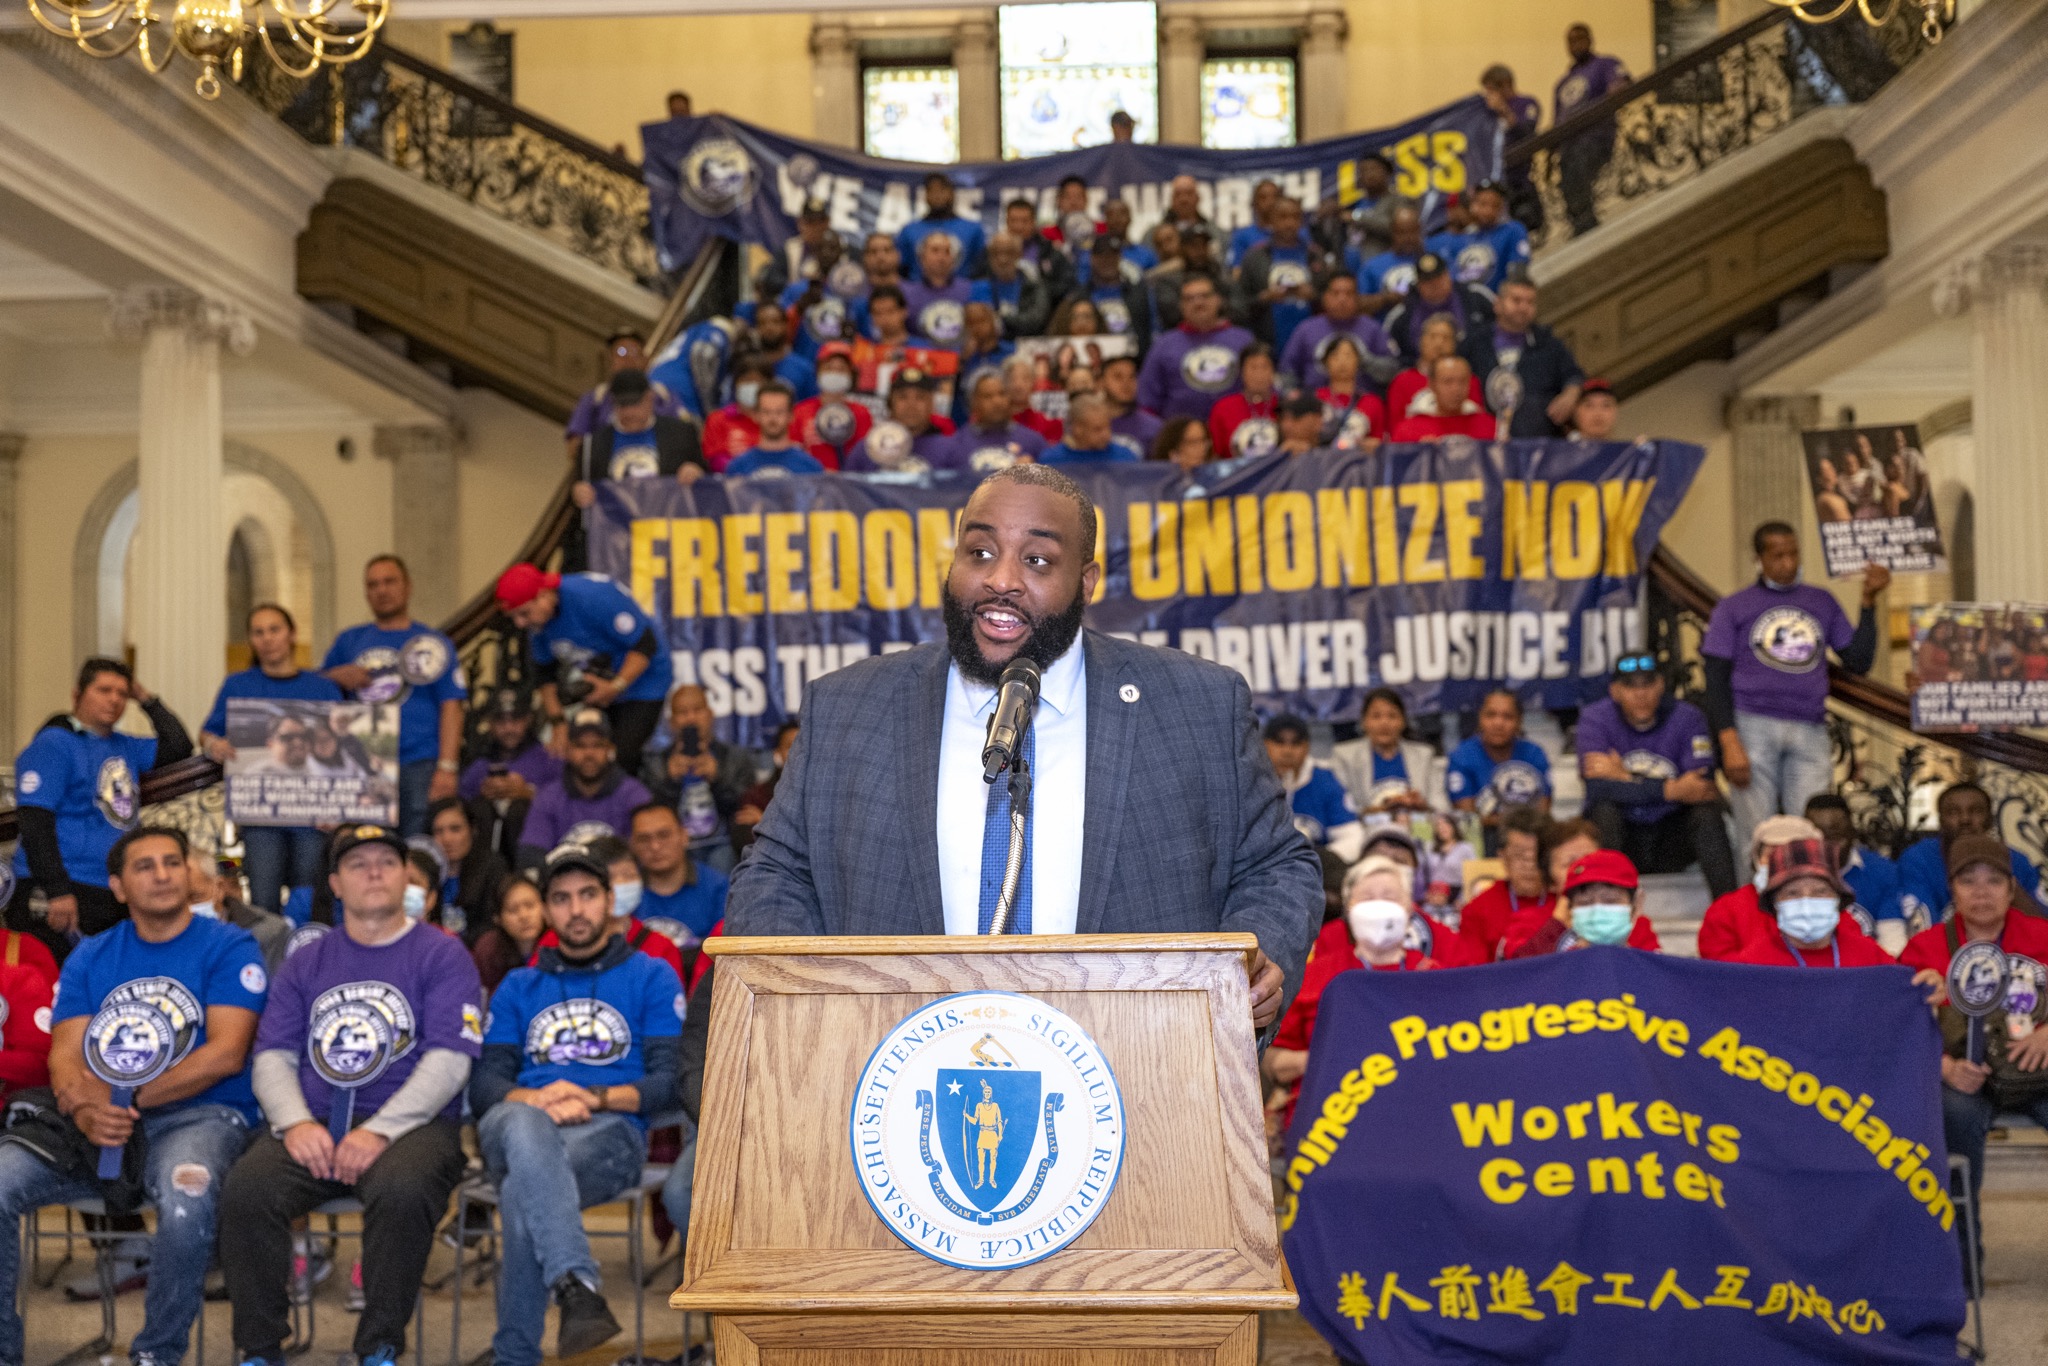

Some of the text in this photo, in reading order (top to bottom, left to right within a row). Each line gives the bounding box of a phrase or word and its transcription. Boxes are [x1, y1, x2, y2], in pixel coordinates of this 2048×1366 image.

[1336, 131, 1467, 206] LSS
[1127, 479, 1485, 600] UNIONIZE
[1853, 516, 1915, 532] FAMILIES
[1380, 605, 1569, 686] JUSTICE
[1953, 680, 2022, 694] FAMILIES
[1027, 1013, 1114, 1125] SIGILLUM
[923, 1102, 932, 1132] ENSE
[1390, 993, 1690, 1060] Progressive
[1700, 1027, 1957, 1232] Association
[1452, 1092, 1740, 1164] Workers
[921, 1133, 933, 1164] PETIT
[932, 1180, 972, 1219] PLACIDAM
[980, 1145, 1113, 1259] REIPUBLICÆ
[997, 1208, 1017, 1222] SVB
[1017, 1160, 1050, 1212] LIBERTATE
